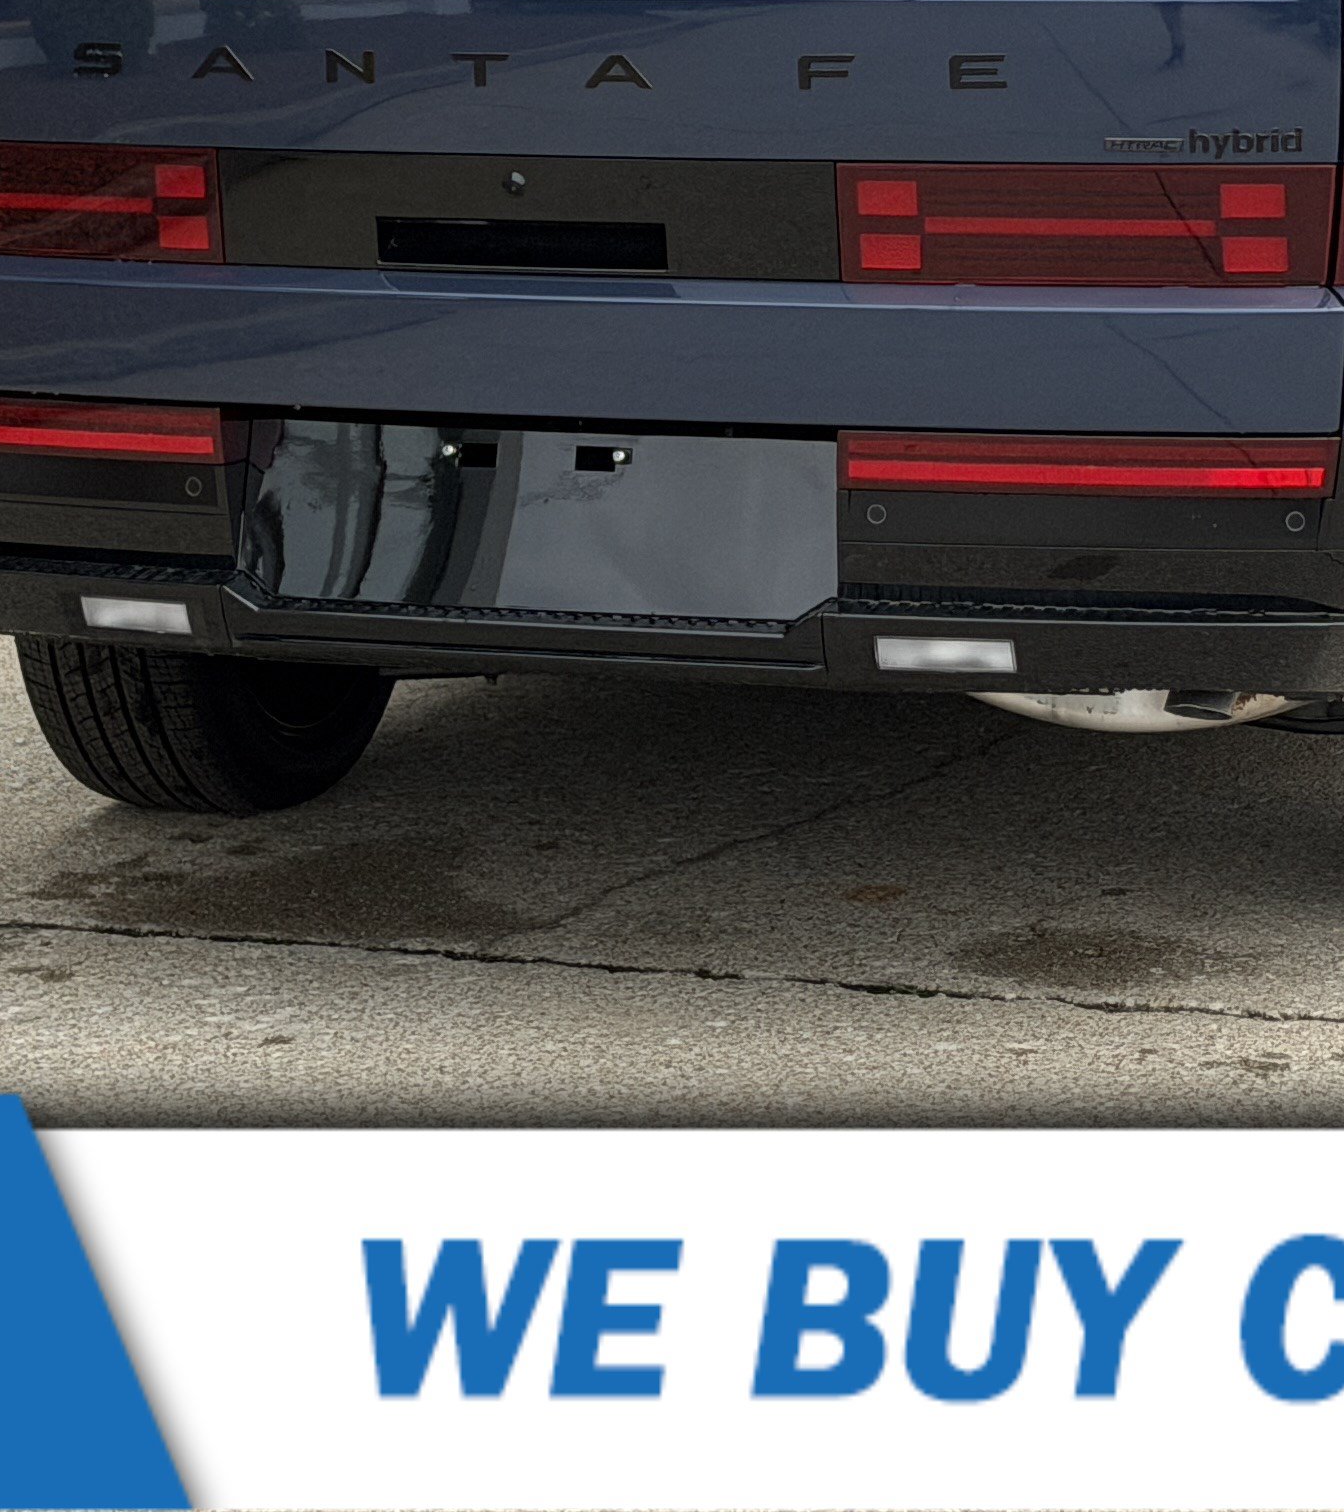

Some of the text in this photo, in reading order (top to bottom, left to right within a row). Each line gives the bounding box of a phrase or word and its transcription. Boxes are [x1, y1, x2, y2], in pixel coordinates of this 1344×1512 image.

[72, 40, 1008, 90] SANTA FE
[1189, 127, 1304, 159] hybrid
